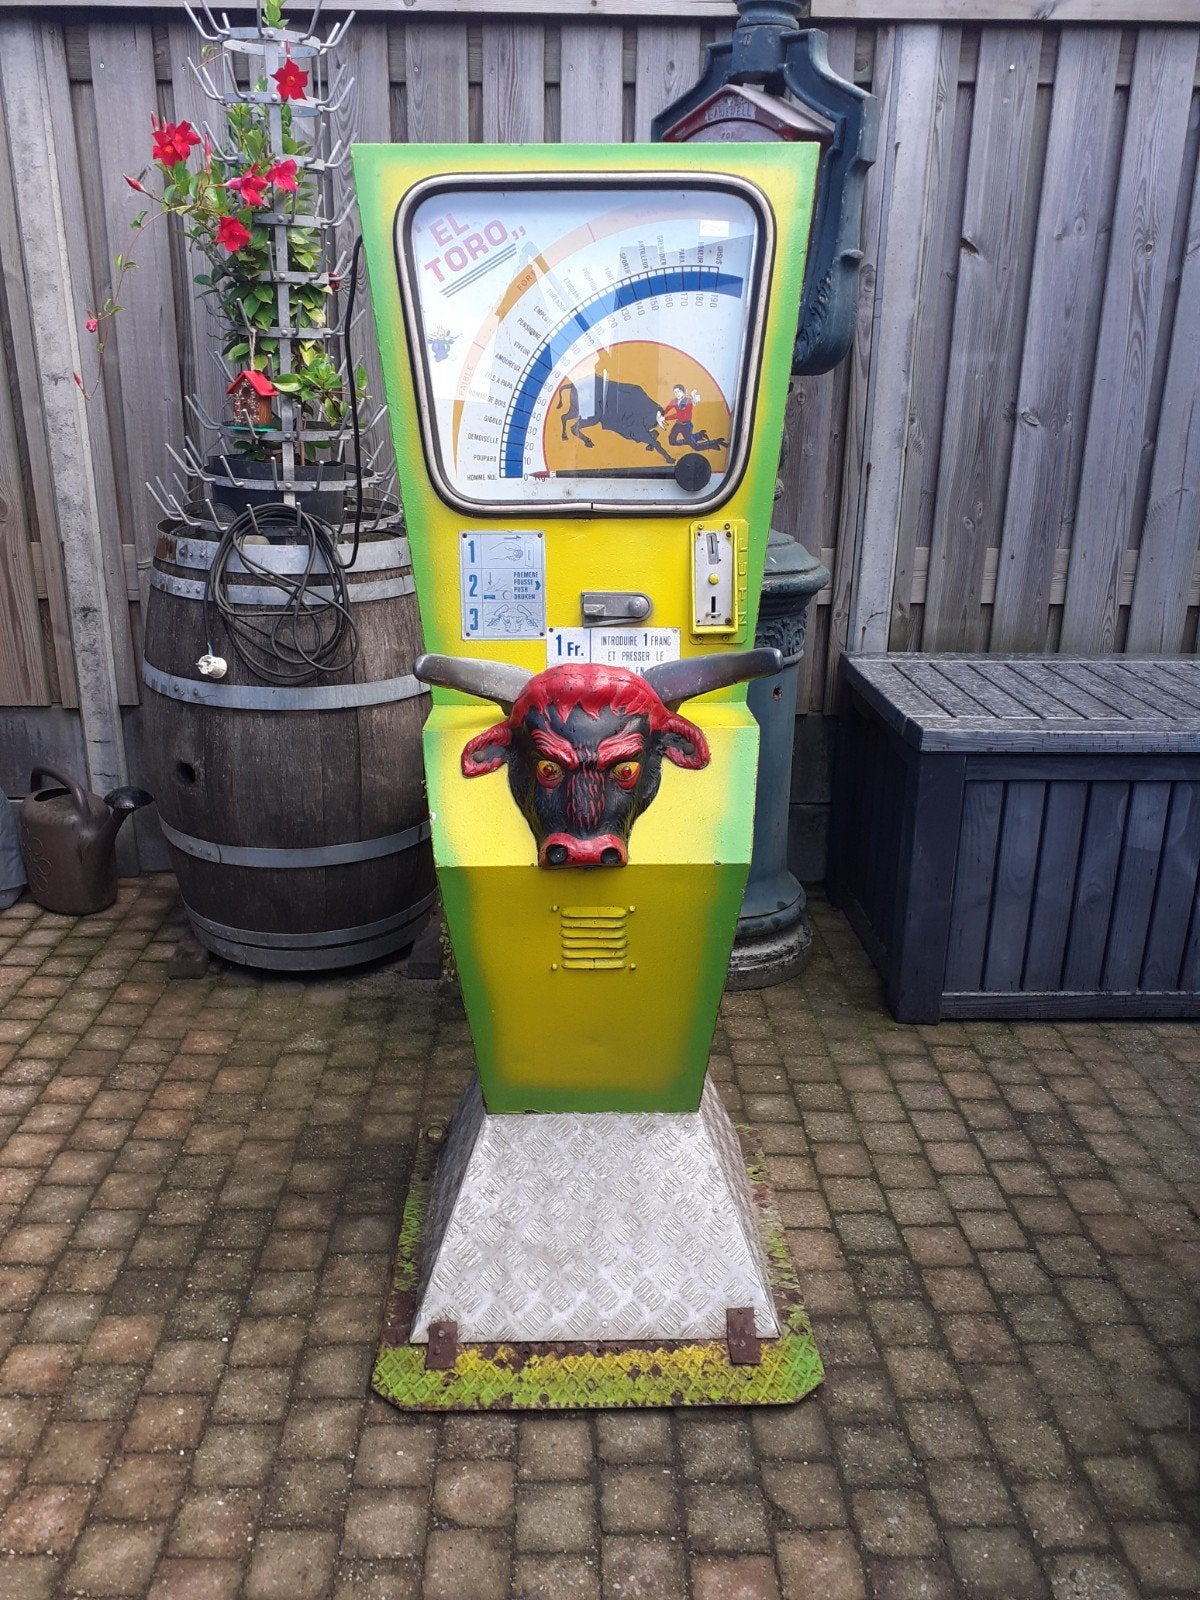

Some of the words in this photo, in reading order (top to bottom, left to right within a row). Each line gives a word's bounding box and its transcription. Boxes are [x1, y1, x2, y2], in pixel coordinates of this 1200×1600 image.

[650, 297, 659, 311] 150
[664, 294, 673, 308] 160
[680, 293, 688, 307] 170
[695, 293, 703, 307] 180
[709, 294, 718, 308] 190
[621, 307, 631, 322] 130
[635, 301, 645, 316] 140
[582, 332, 595, 347] 100
[570, 344, 581, 355] 90
[458, 365, 474, 396] FAIBLE
[551, 370, 561, 379] 70
[544, 382, 553, 392] 60
[536, 397, 546, 407] 50
[531, 412, 541, 422] 40
[528, 426, 537, 436] 30
[525, 442, 534, 451] 20
[524, 457, 531, 465] 10
[468, 540, 475, 563] 1
[469, 574, 478, 597] 2
[469, 608, 479, 631] 3
[556, 634, 562, 657] 1
[567, 642, 584, 657] Fr.
[600, 636, 637, 646] INTRODUIRE
[643, 633, 648, 646] 1
[651, 636, 671, 646] FRANC
[608, 651, 616, 661] ET
[622, 651, 650, 661] PRESSER
[656, 651, 664, 661] LE
